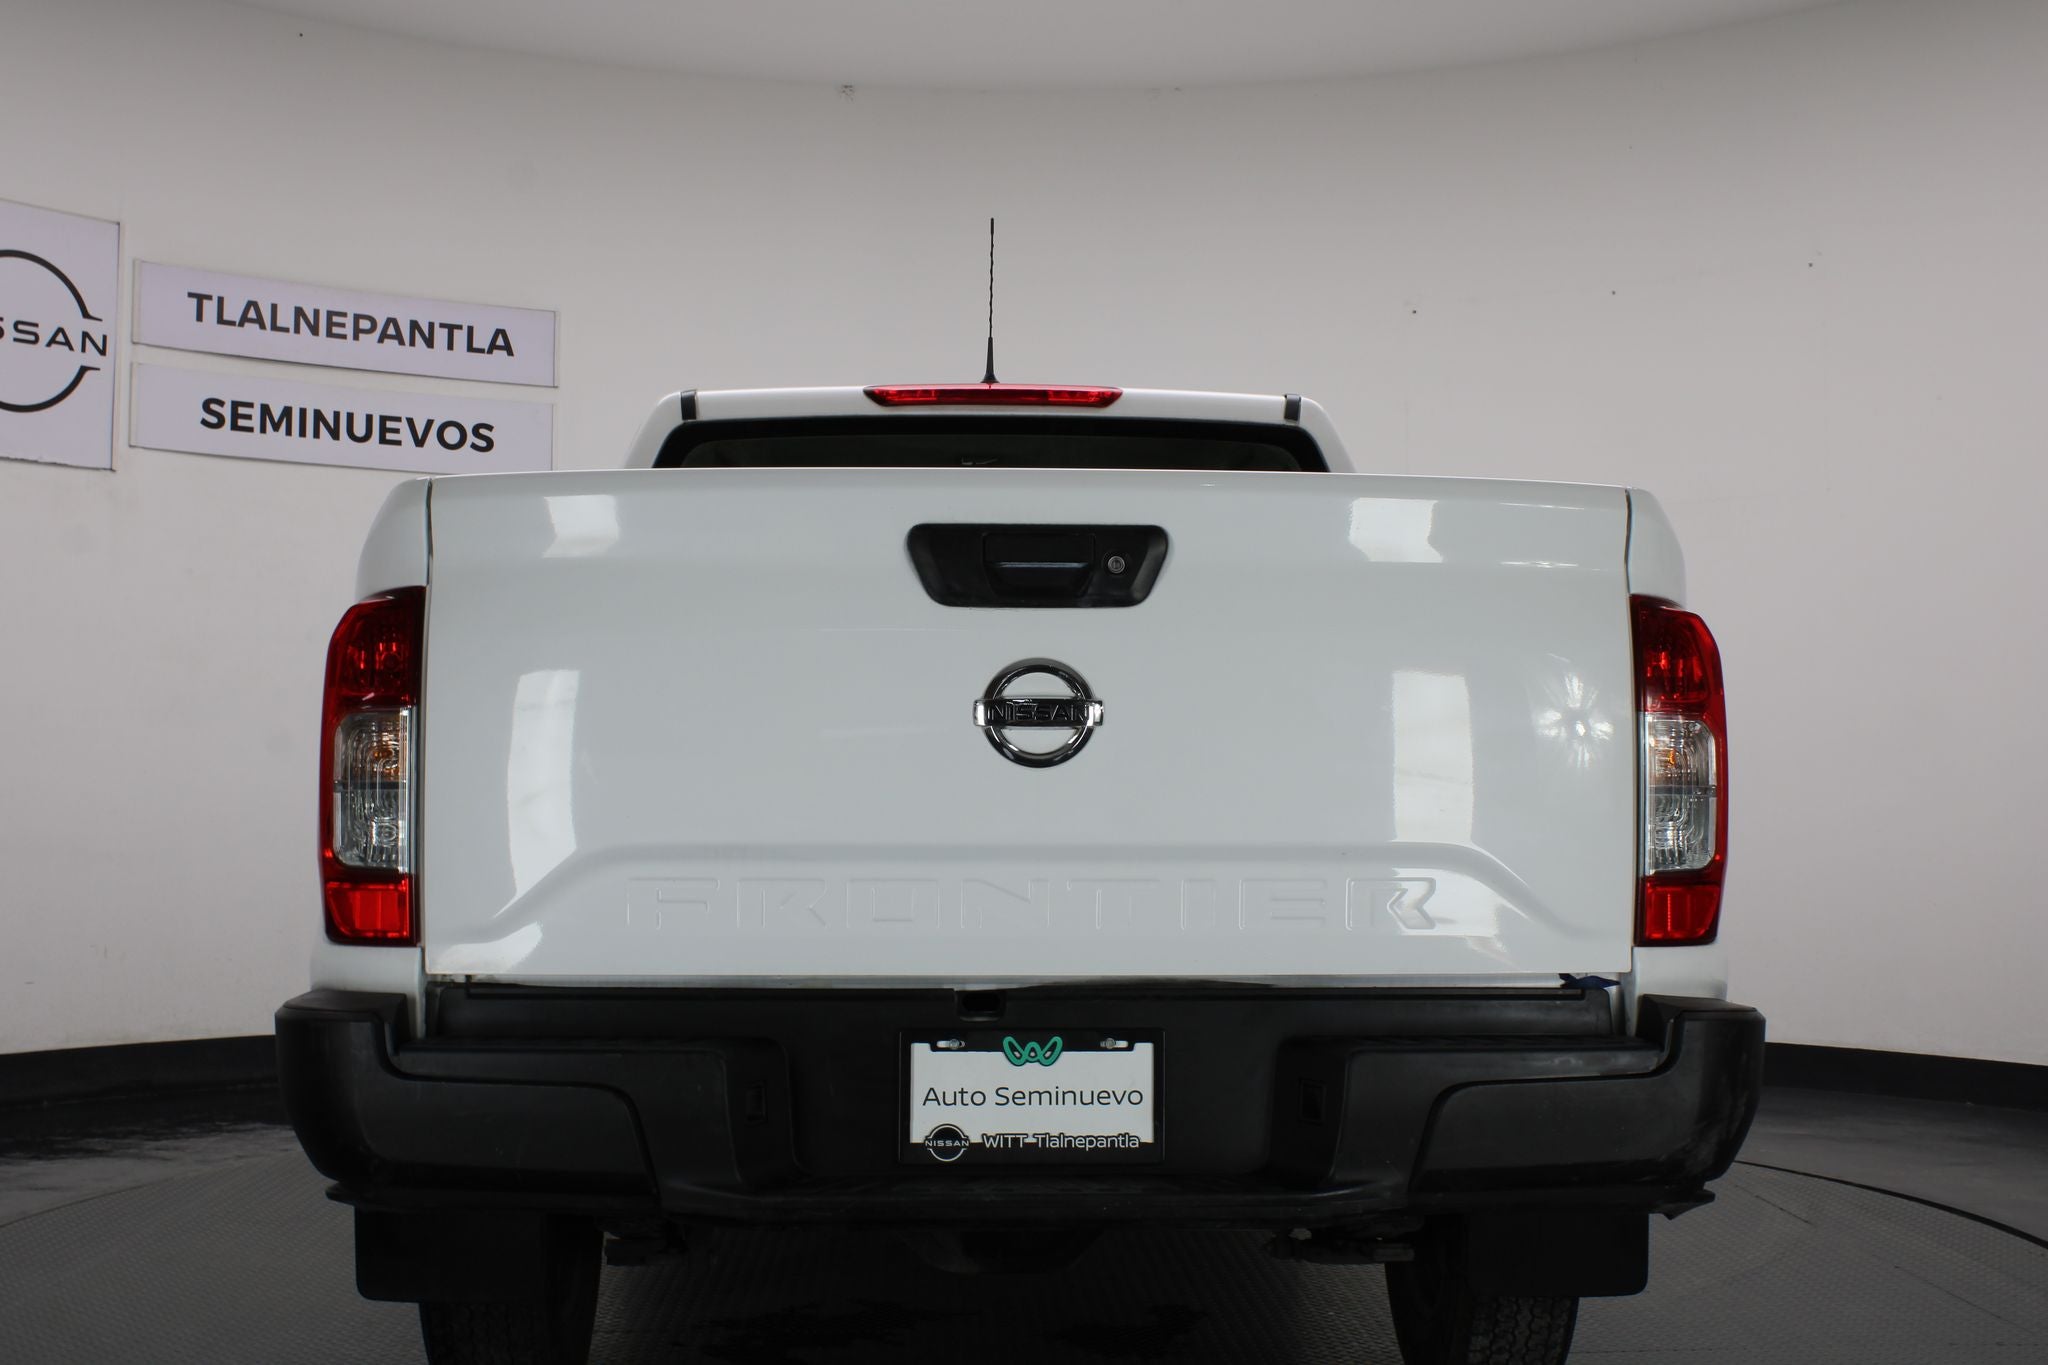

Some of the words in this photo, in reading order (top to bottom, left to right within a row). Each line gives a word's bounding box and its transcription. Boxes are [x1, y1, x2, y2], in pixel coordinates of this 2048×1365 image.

[0, 316, 107, 357] SAN
[187, 291, 515, 357] TLALNEPANTLA
[200, 397, 495, 453] SEMINUEVOS
[987, 703, 1088, 721] NISSAN
[626, 877, 1437, 931] FRONTIER
[922, 1086, 987, 1106] Auto
[994, 1086, 1144, 1106] Seminuevo
[925, 1139, 970, 1147] NISSAN
[983, 1133, 1028, 1148] WITT
[1034, 1132, 1140, 1151] Tlalnepantla
